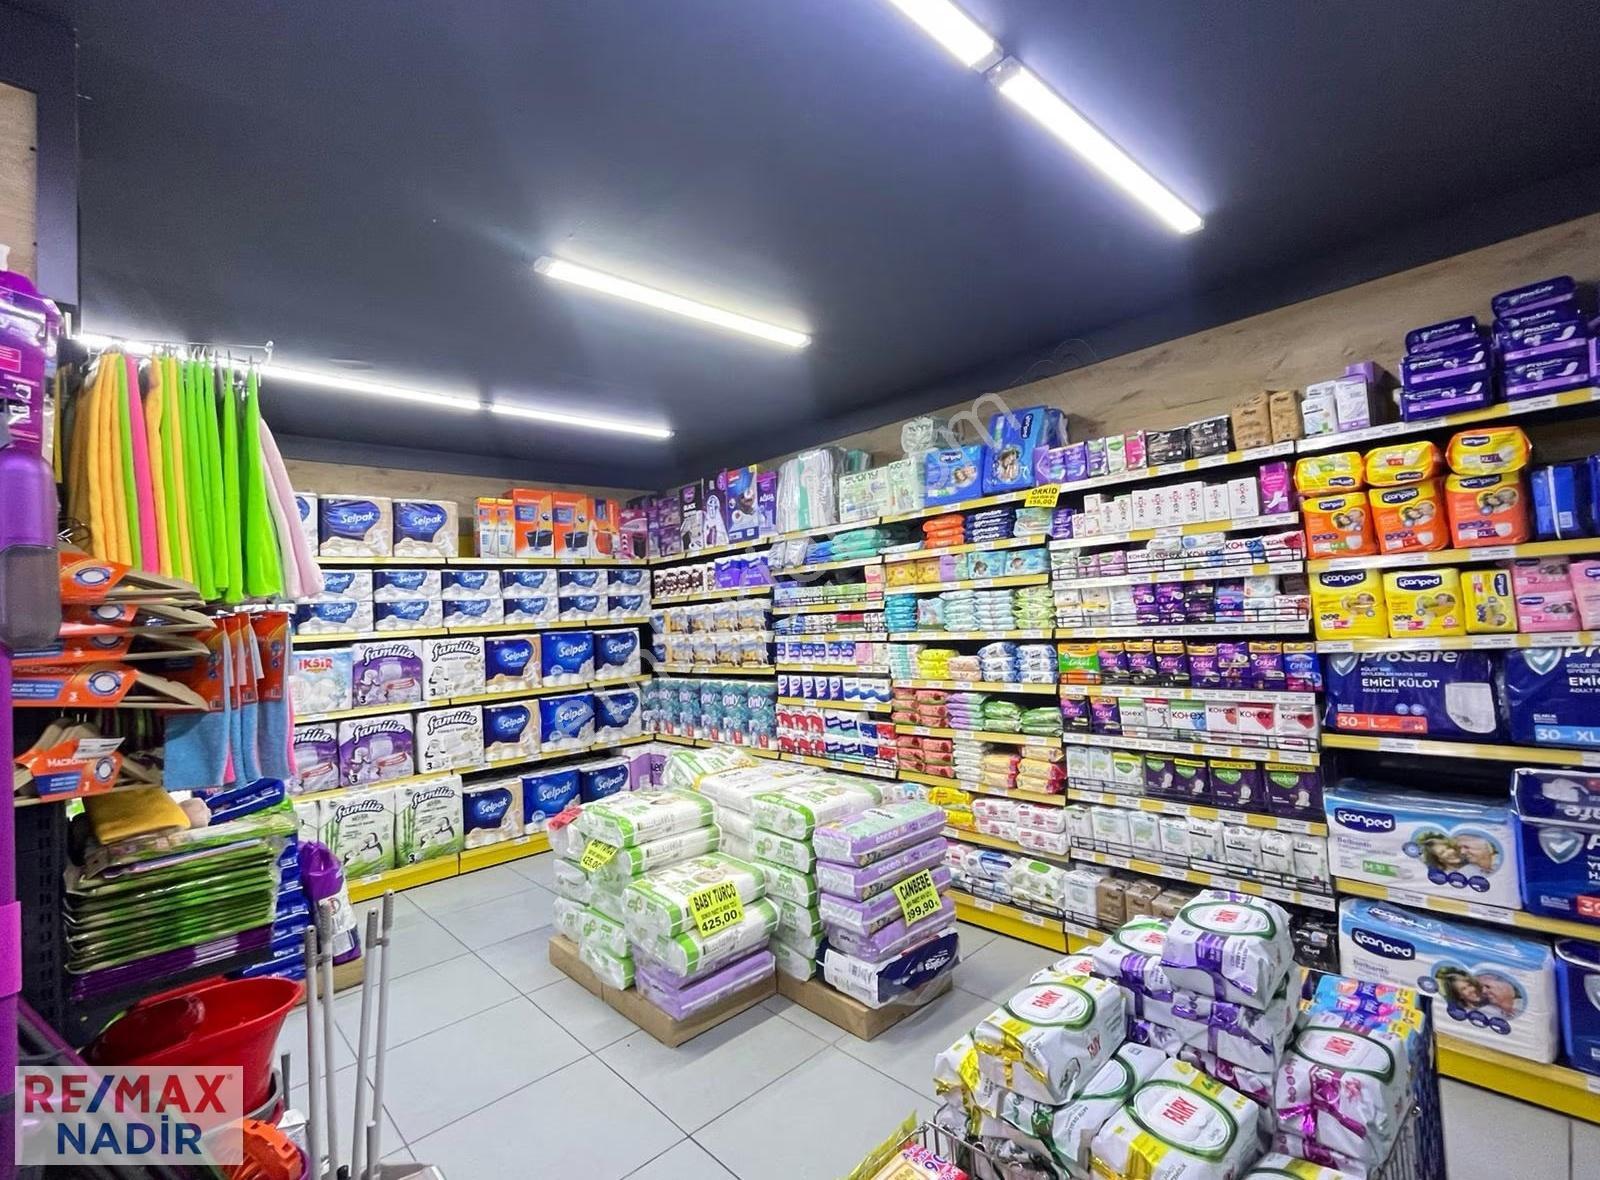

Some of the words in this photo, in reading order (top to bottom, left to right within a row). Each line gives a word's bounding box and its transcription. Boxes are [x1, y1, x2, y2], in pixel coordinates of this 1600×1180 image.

[341, 512, 376, 525] Selpak
[412, 514, 442, 527] Selpak
[432, 640, 480, 662] familia
[559, 642, 588, 657] Selpak
[609, 640, 634, 654] Selpak
[364, 645, 415, 665] familia
[504, 649, 529, 662] Selpak
[1361, 677, 1395, 688] EMİCİ
[1399, 678, 1440, 688] KÜLOT
[1569, 675, 1600, 687] EMİ
[723, 694, 740, 706] Only
[748, 696, 766, 709] Only
[558, 706, 588, 722] Selpak
[1340, 715, 1358, 727] 30
[427, 711, 477, 735] familia
[500, 716, 527, 729] Selpak
[294, 729, 332, 743] milia
[353, 719, 405, 743] familia
[1537, 727, 1560, 740] 30
[1576, 730, 1596, 743] XL
[597, 773, 625, 791] Selpak
[412, 786, 455, 808] familia
[540, 781, 573, 801] Selpak
[335, 800, 384, 823] familia
[479, 798, 508, 814] Selpak
[900, 873, 931, 900] CANBEBE
[693, 891, 713, 911] BABY
[713, 884, 736, 903] TURCO
[702, 910, 737, 931] 425,00
[1355, 930, 1412, 957] canped
